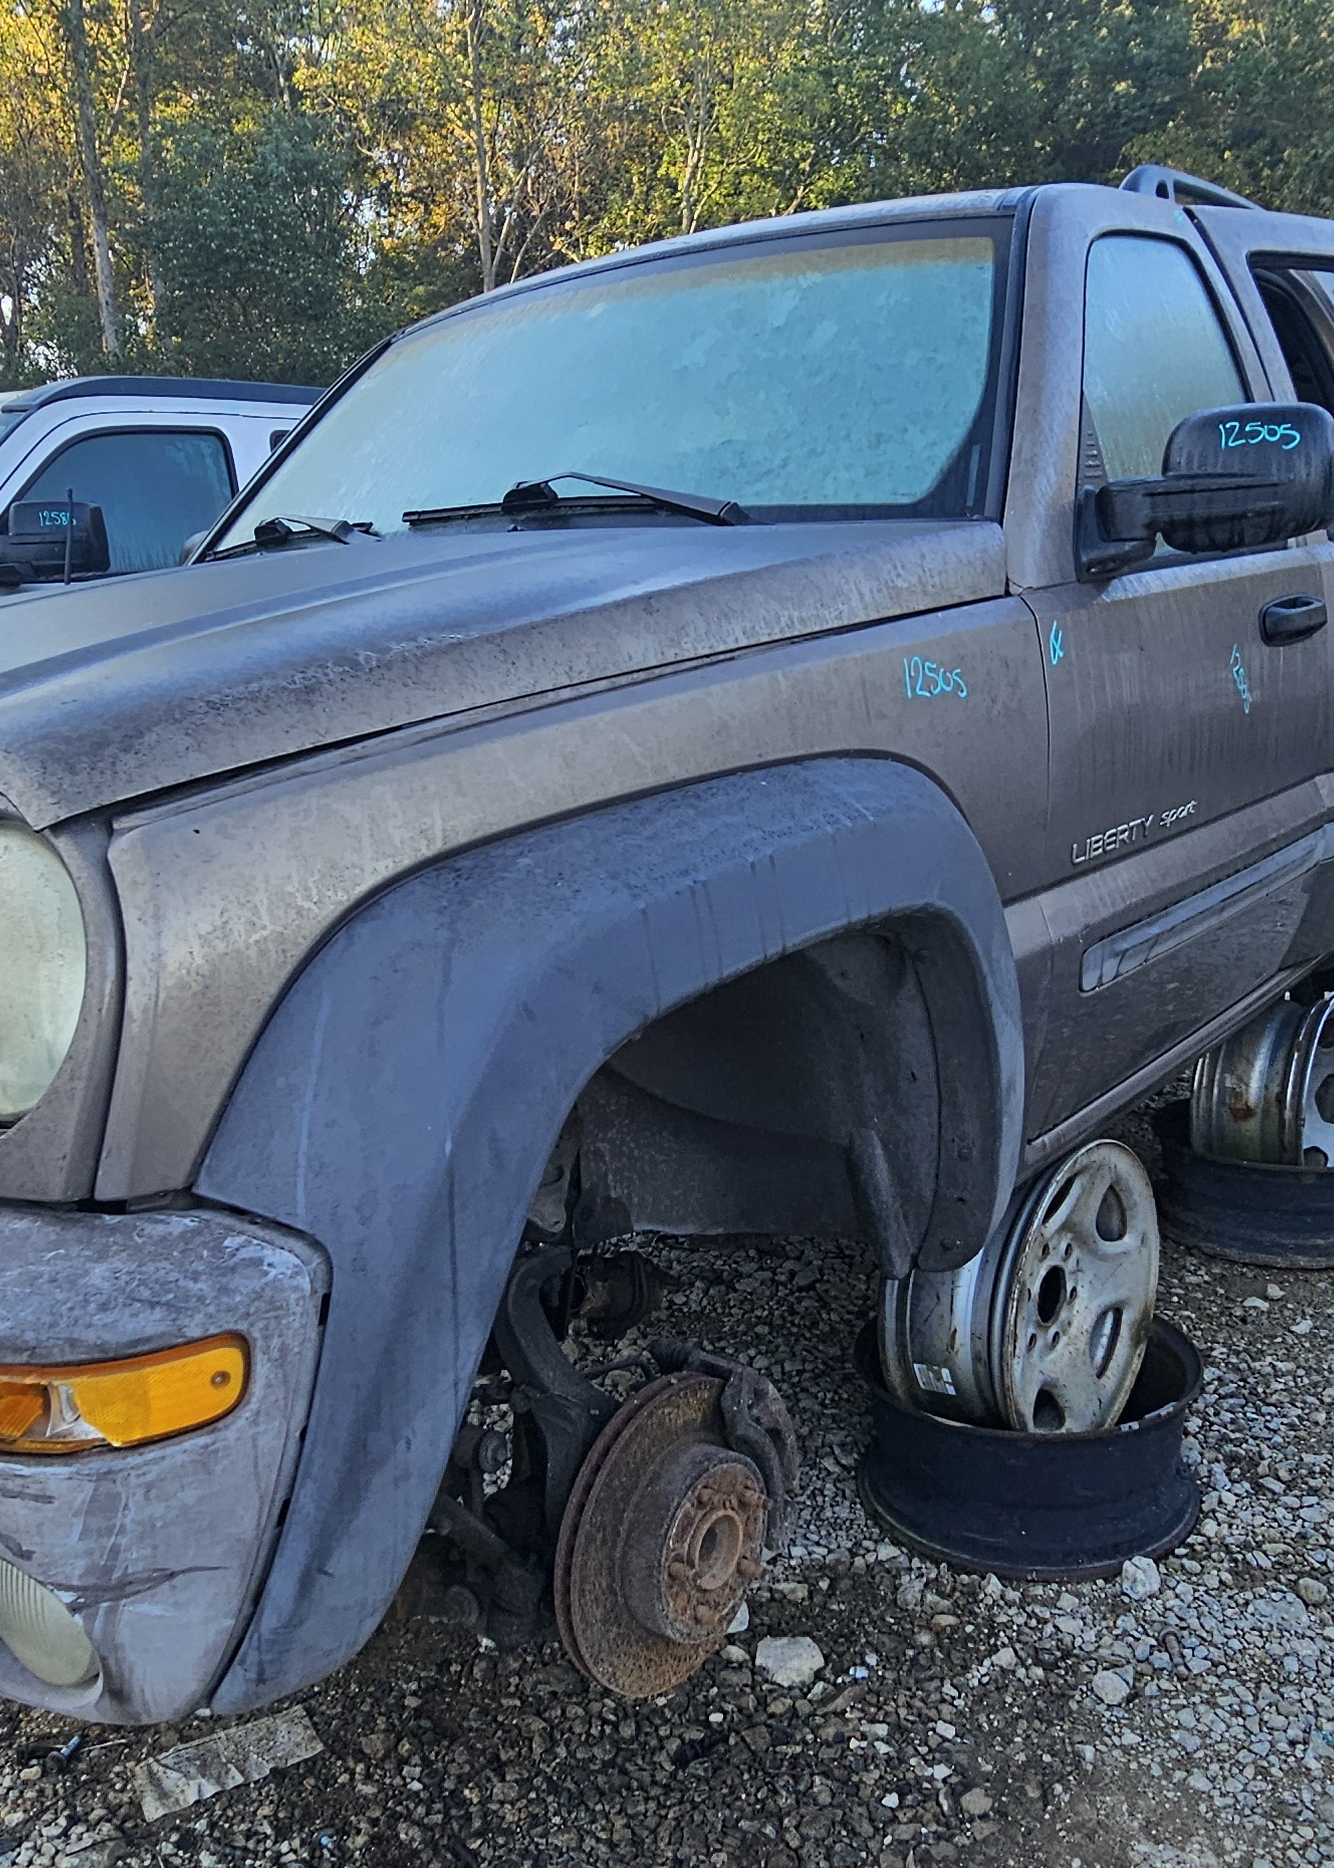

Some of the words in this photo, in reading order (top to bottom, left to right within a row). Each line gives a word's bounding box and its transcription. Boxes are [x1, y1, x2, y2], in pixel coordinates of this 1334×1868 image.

[1219, 421, 1301, 449] 12505
[903, 654, 969, 699] 12505
[1070, 813, 1154, 865] LIBERTY
[1160, 800, 1198, 827] sport
